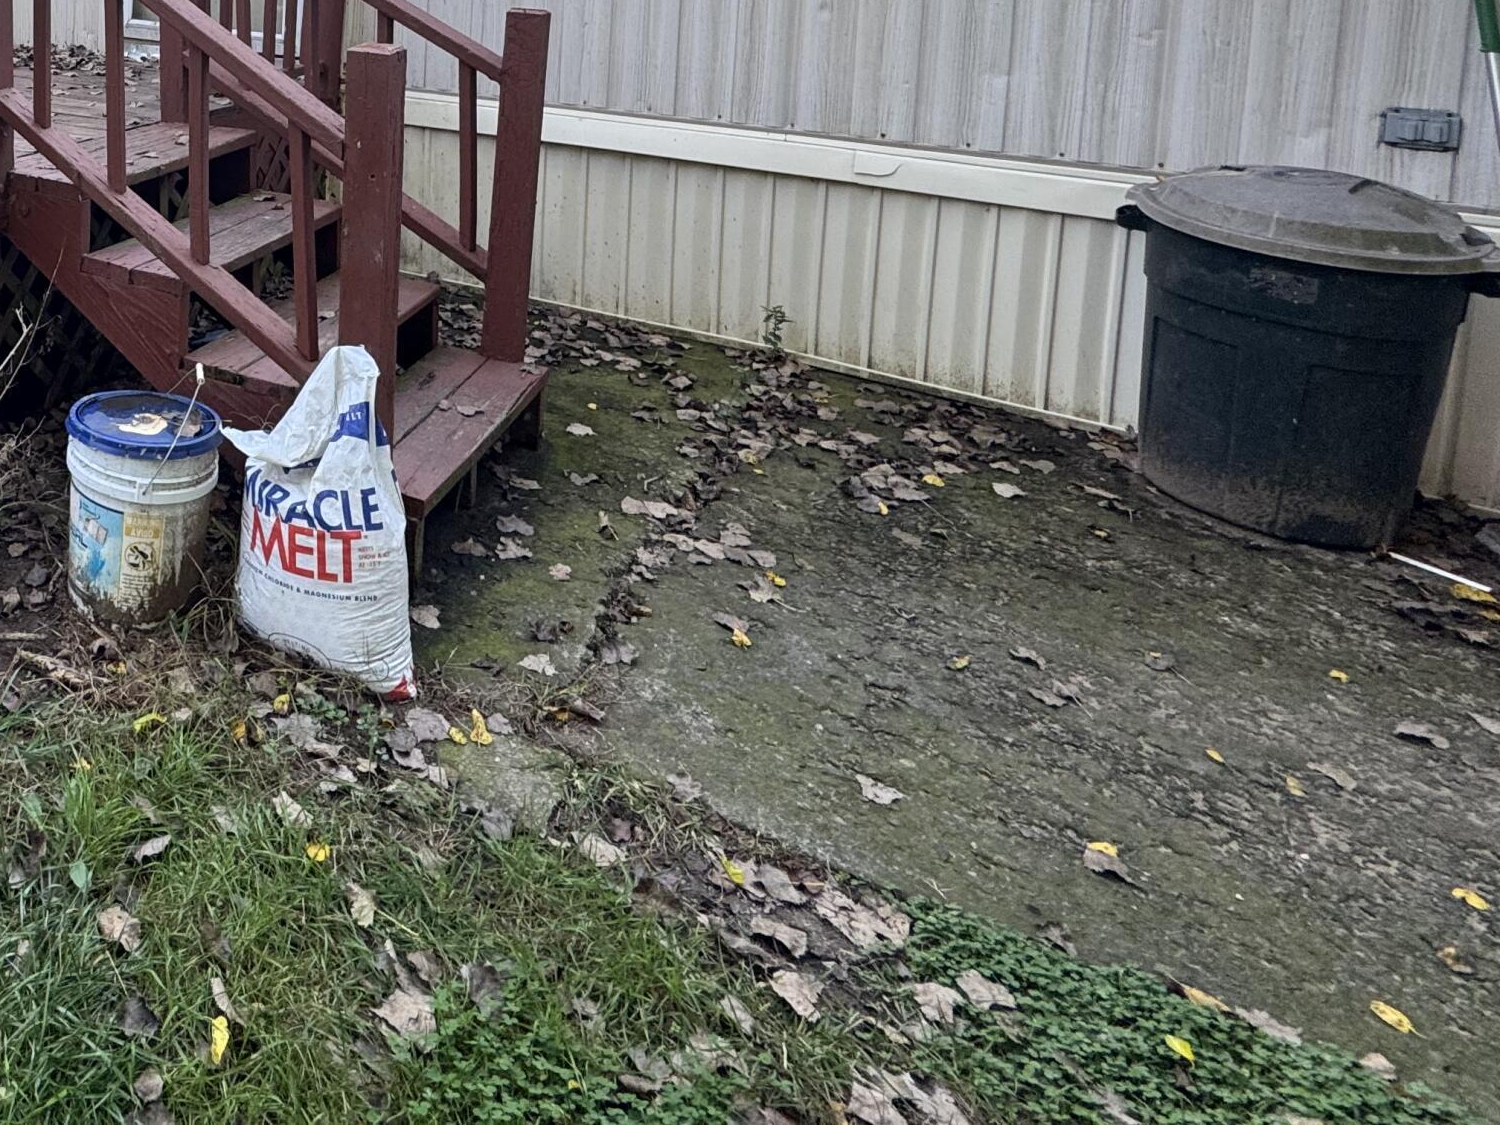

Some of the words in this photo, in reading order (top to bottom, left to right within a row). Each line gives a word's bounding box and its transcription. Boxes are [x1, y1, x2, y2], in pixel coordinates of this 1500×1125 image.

[245, 466, 383, 533] MIRACLE
[250, 506, 362, 584] MELT
[304, 589, 351, 601] MAGNESIUM
